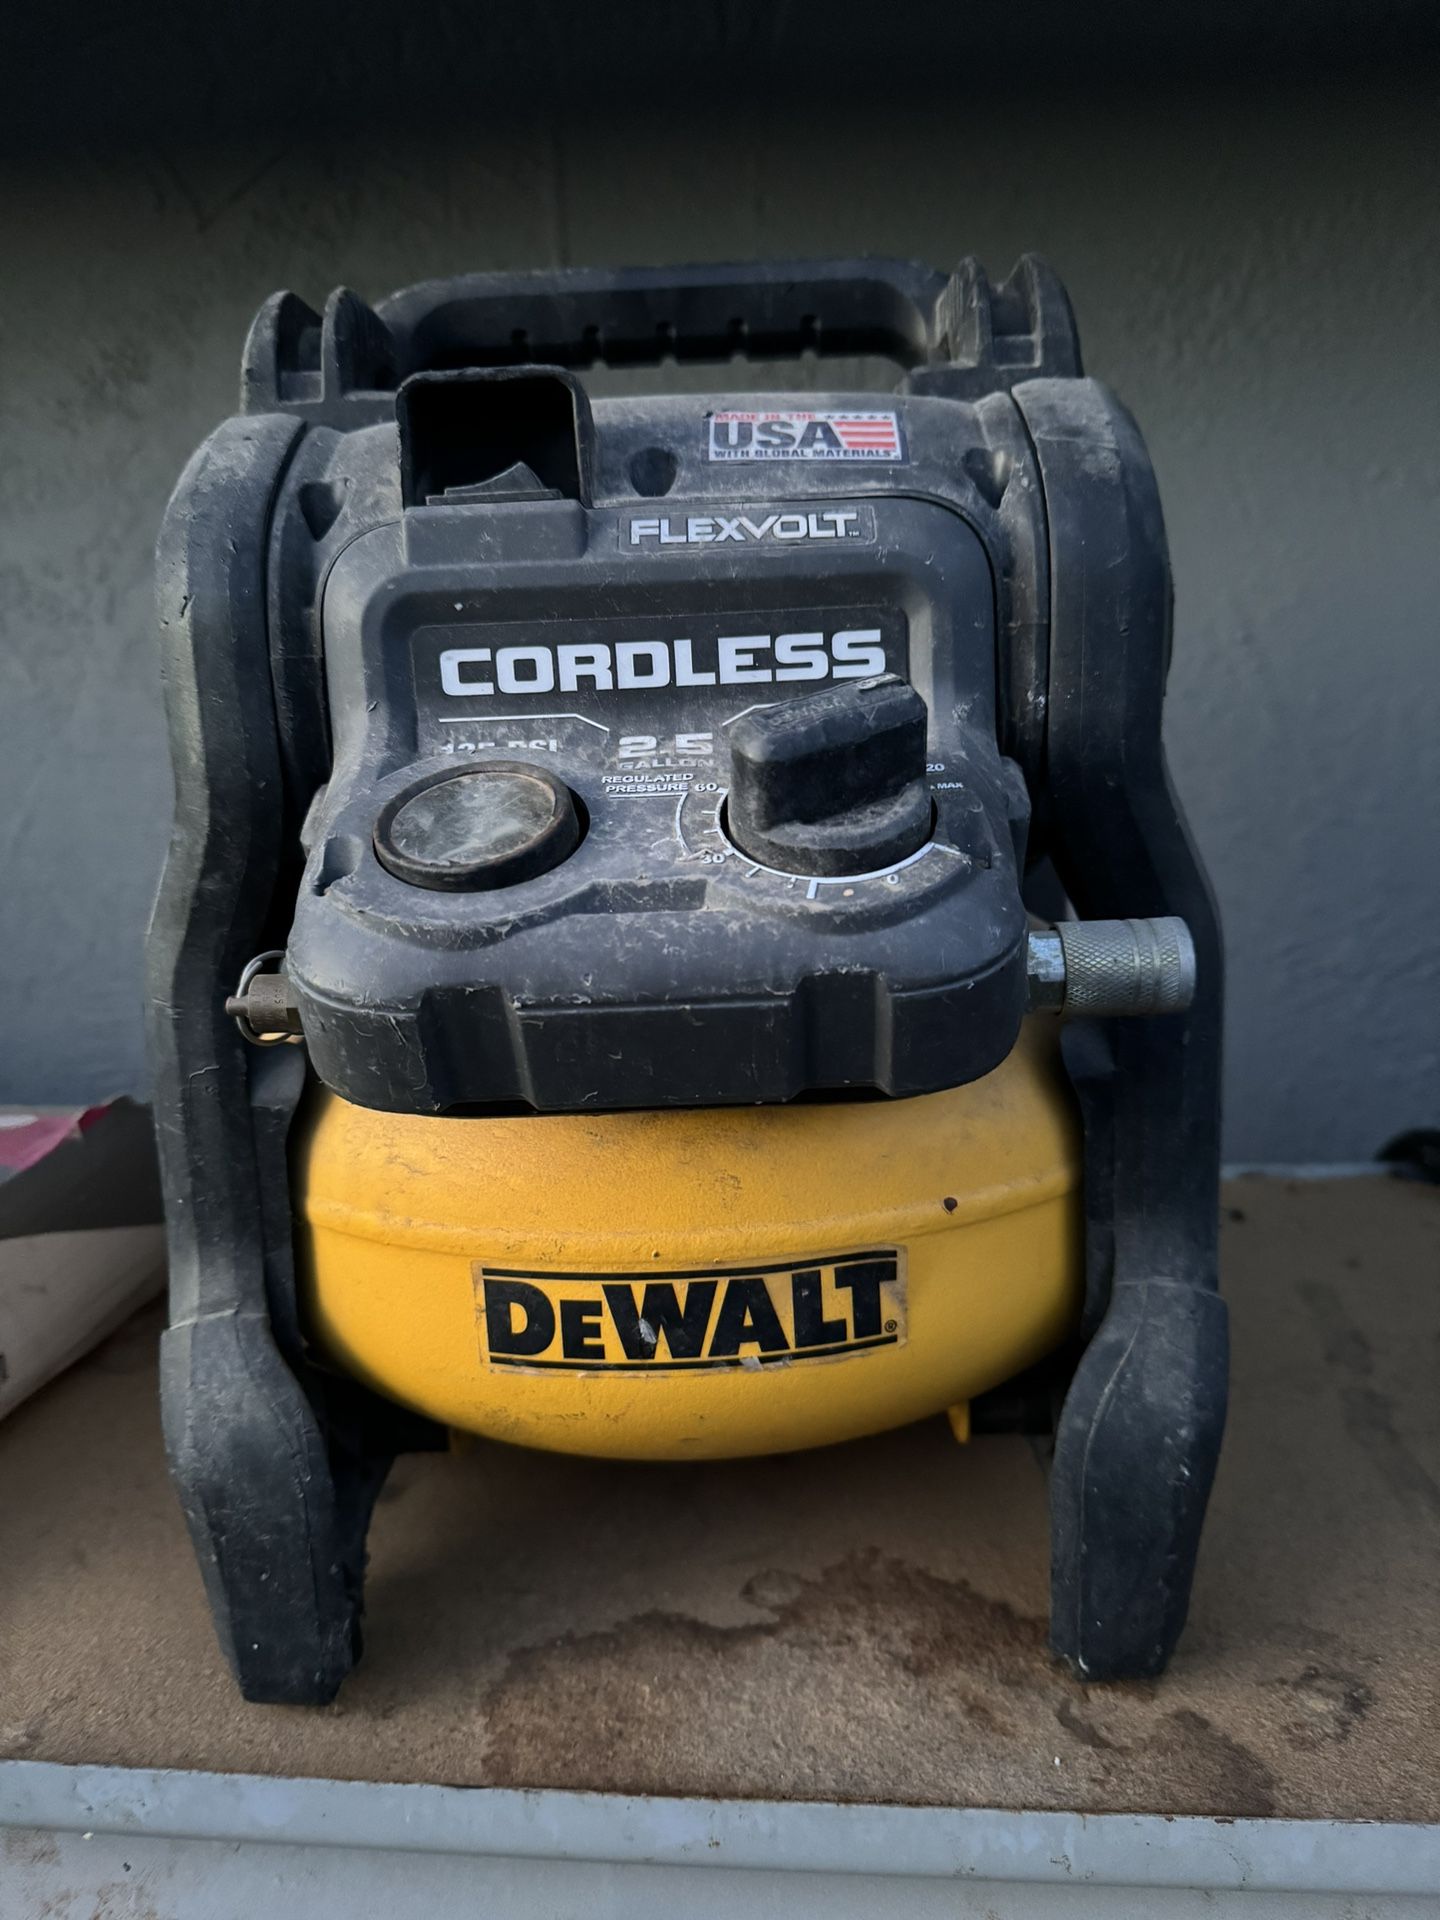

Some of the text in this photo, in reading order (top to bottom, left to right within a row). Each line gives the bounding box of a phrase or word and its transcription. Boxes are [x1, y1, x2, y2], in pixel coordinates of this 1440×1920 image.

[715, 411, 816, 422] MADE IN THE
[713, 420, 844, 450] USA
[714, 448, 892, 459] WITH GLOBAL MATERIALS
[439, 629, 886, 697] CORDLESS
[618, 732, 714, 759] 2.5
[618, 758, 715, 770] GALLON
[602, 773, 694, 784] REGULATED
[605, 783, 689, 793] PRESSURE
[695, 782, 718, 792] 60
[937, 782, 964, 790] MAX
[701, 853, 726, 865] 30
